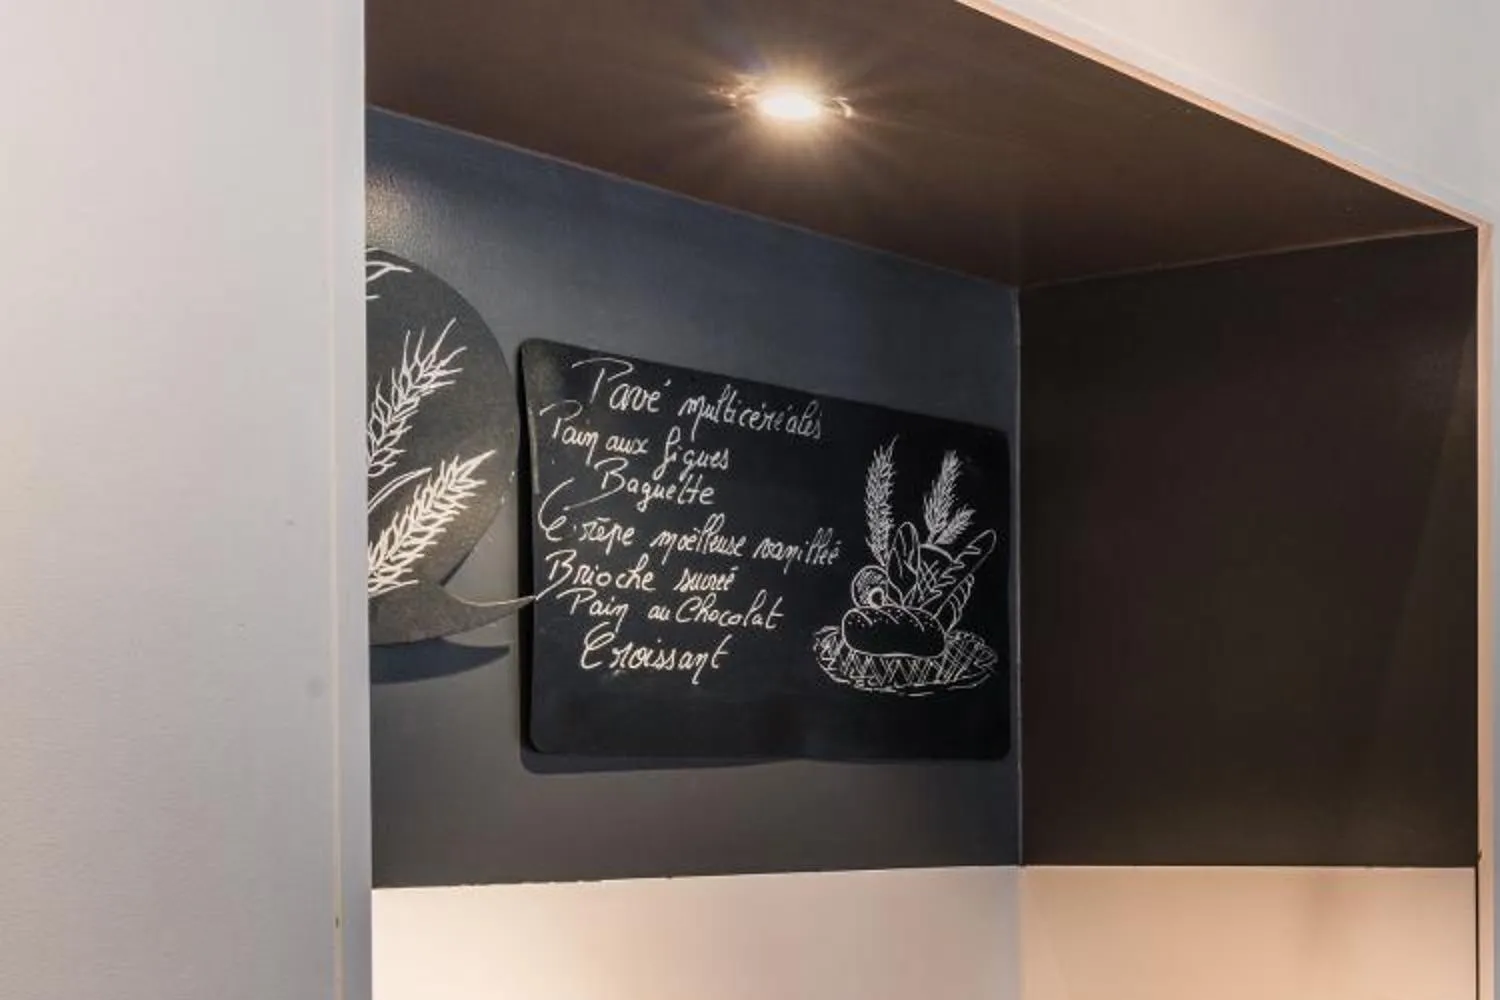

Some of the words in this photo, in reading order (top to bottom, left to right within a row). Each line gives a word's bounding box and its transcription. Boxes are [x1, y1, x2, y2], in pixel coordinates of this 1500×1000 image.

[571, 356, 672, 414] Pavé
[539, 399, 598, 466] Pain
[605, 433, 650, 455] aux
[651, 425, 730, 481] figues
[563, 456, 716, 513] Baguette
[540, 548, 656, 598] Brioche
[555, 586, 630, 633] Pain
[647, 604, 671, 622] au
[674, 588, 785, 630] Chocolat
[579, 621, 734, 685] Croissant
